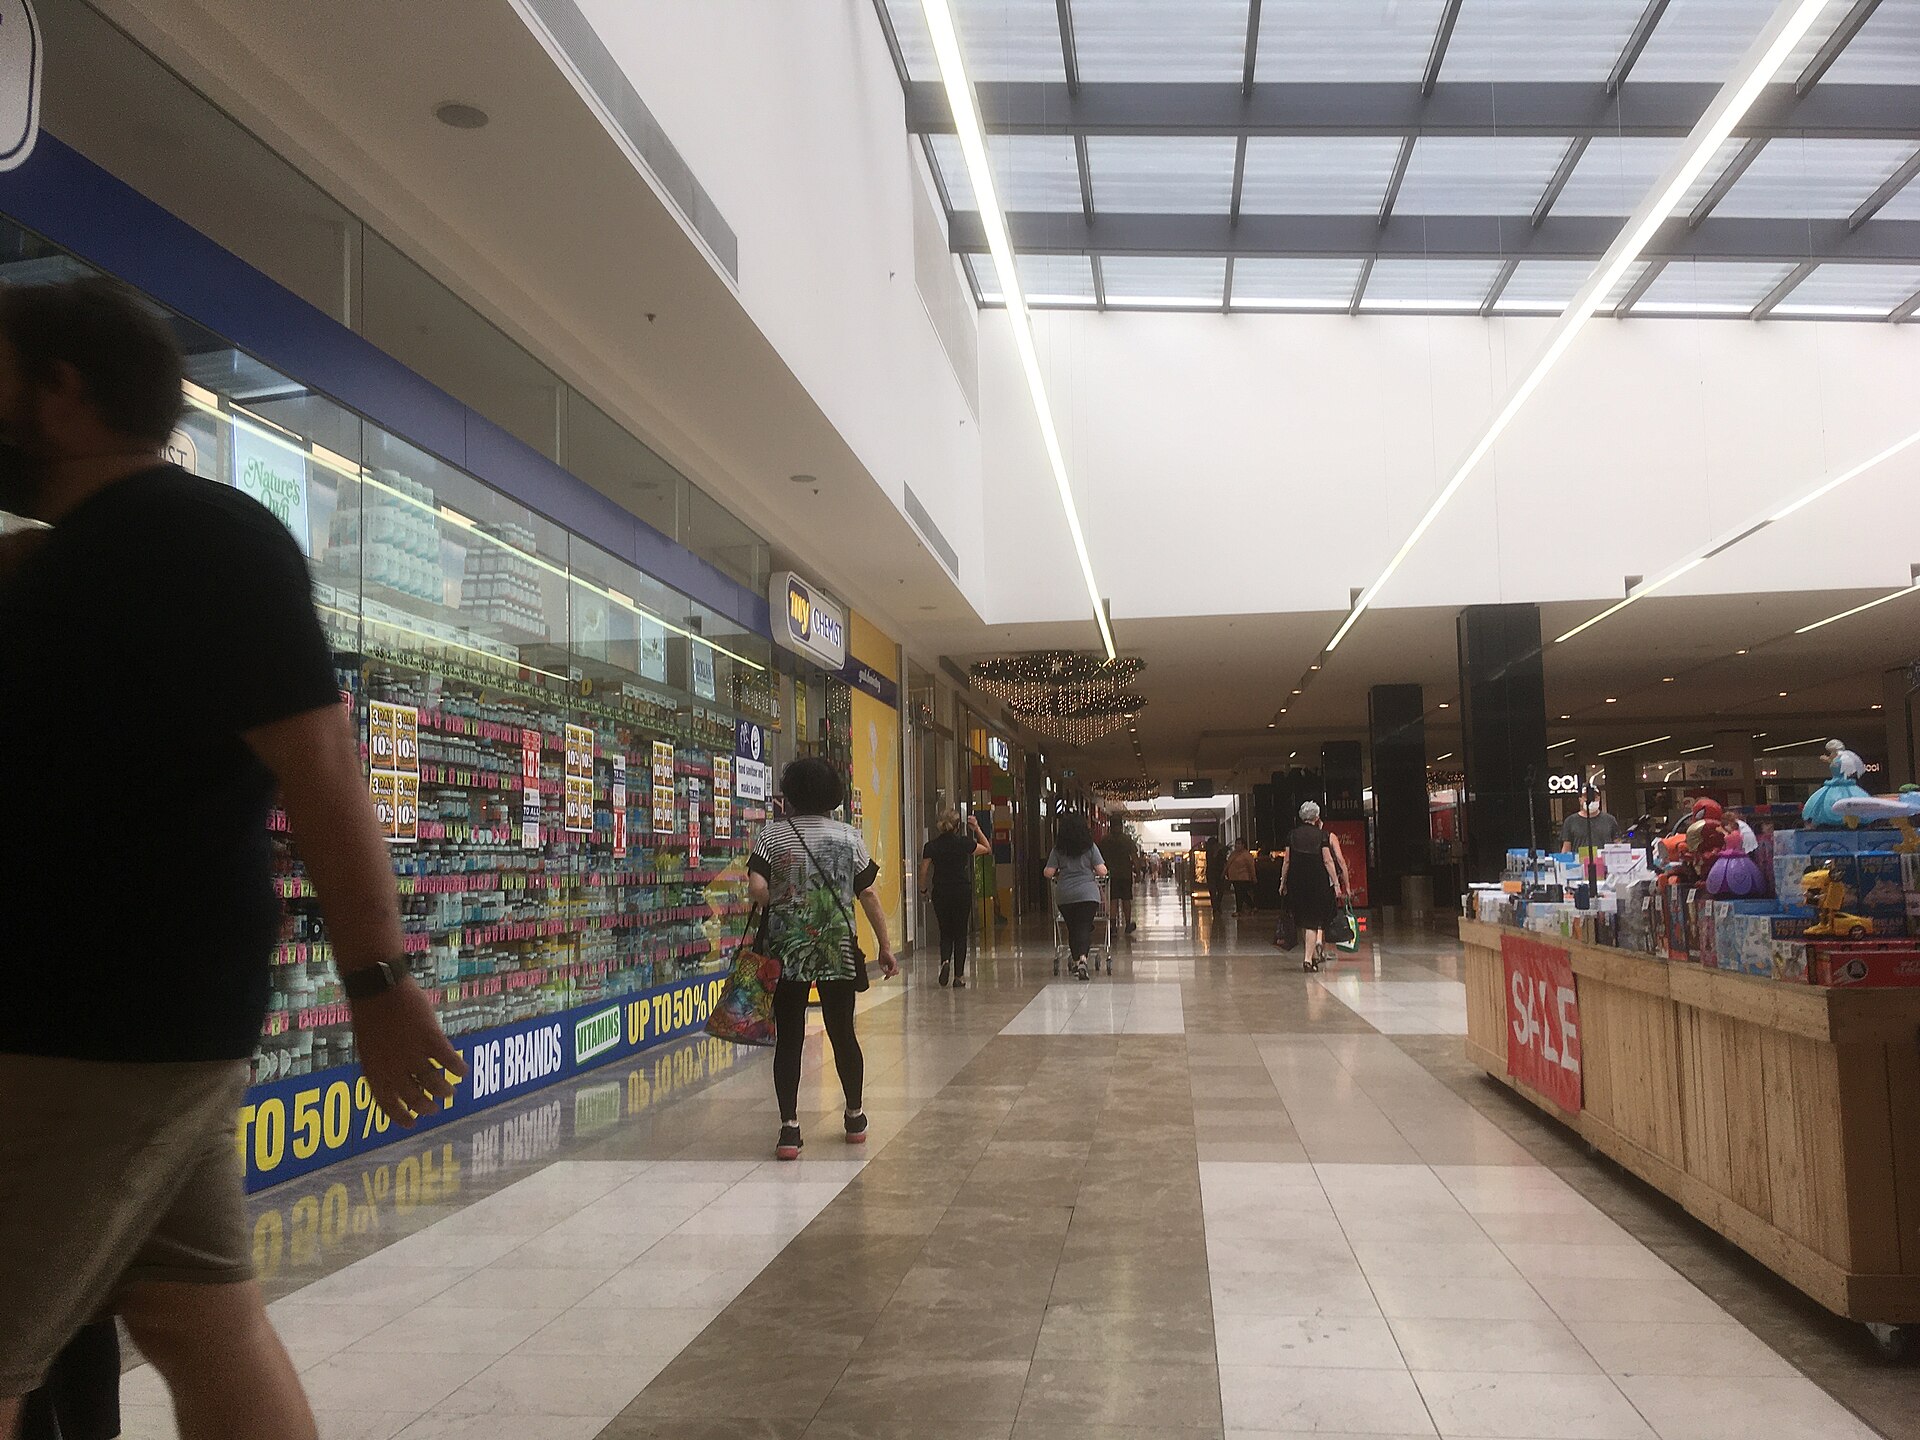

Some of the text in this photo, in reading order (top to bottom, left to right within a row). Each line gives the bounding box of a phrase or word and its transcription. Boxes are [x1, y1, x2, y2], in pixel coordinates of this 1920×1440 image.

[244, 457, 300, 506] Nature's
[790, 590, 842, 648] my CHEMIST
[577, 1010, 620, 1054] VITAMINS
[627, 999, 650, 1045] UP
[653, 993, 672, 1036] TO
[674, 983, 707, 1030] 50%
[1512, 970, 1579, 1074] SALE
[473, 1040, 500, 1099] BIG
[504, 1023, 562, 1089] BRANDS
